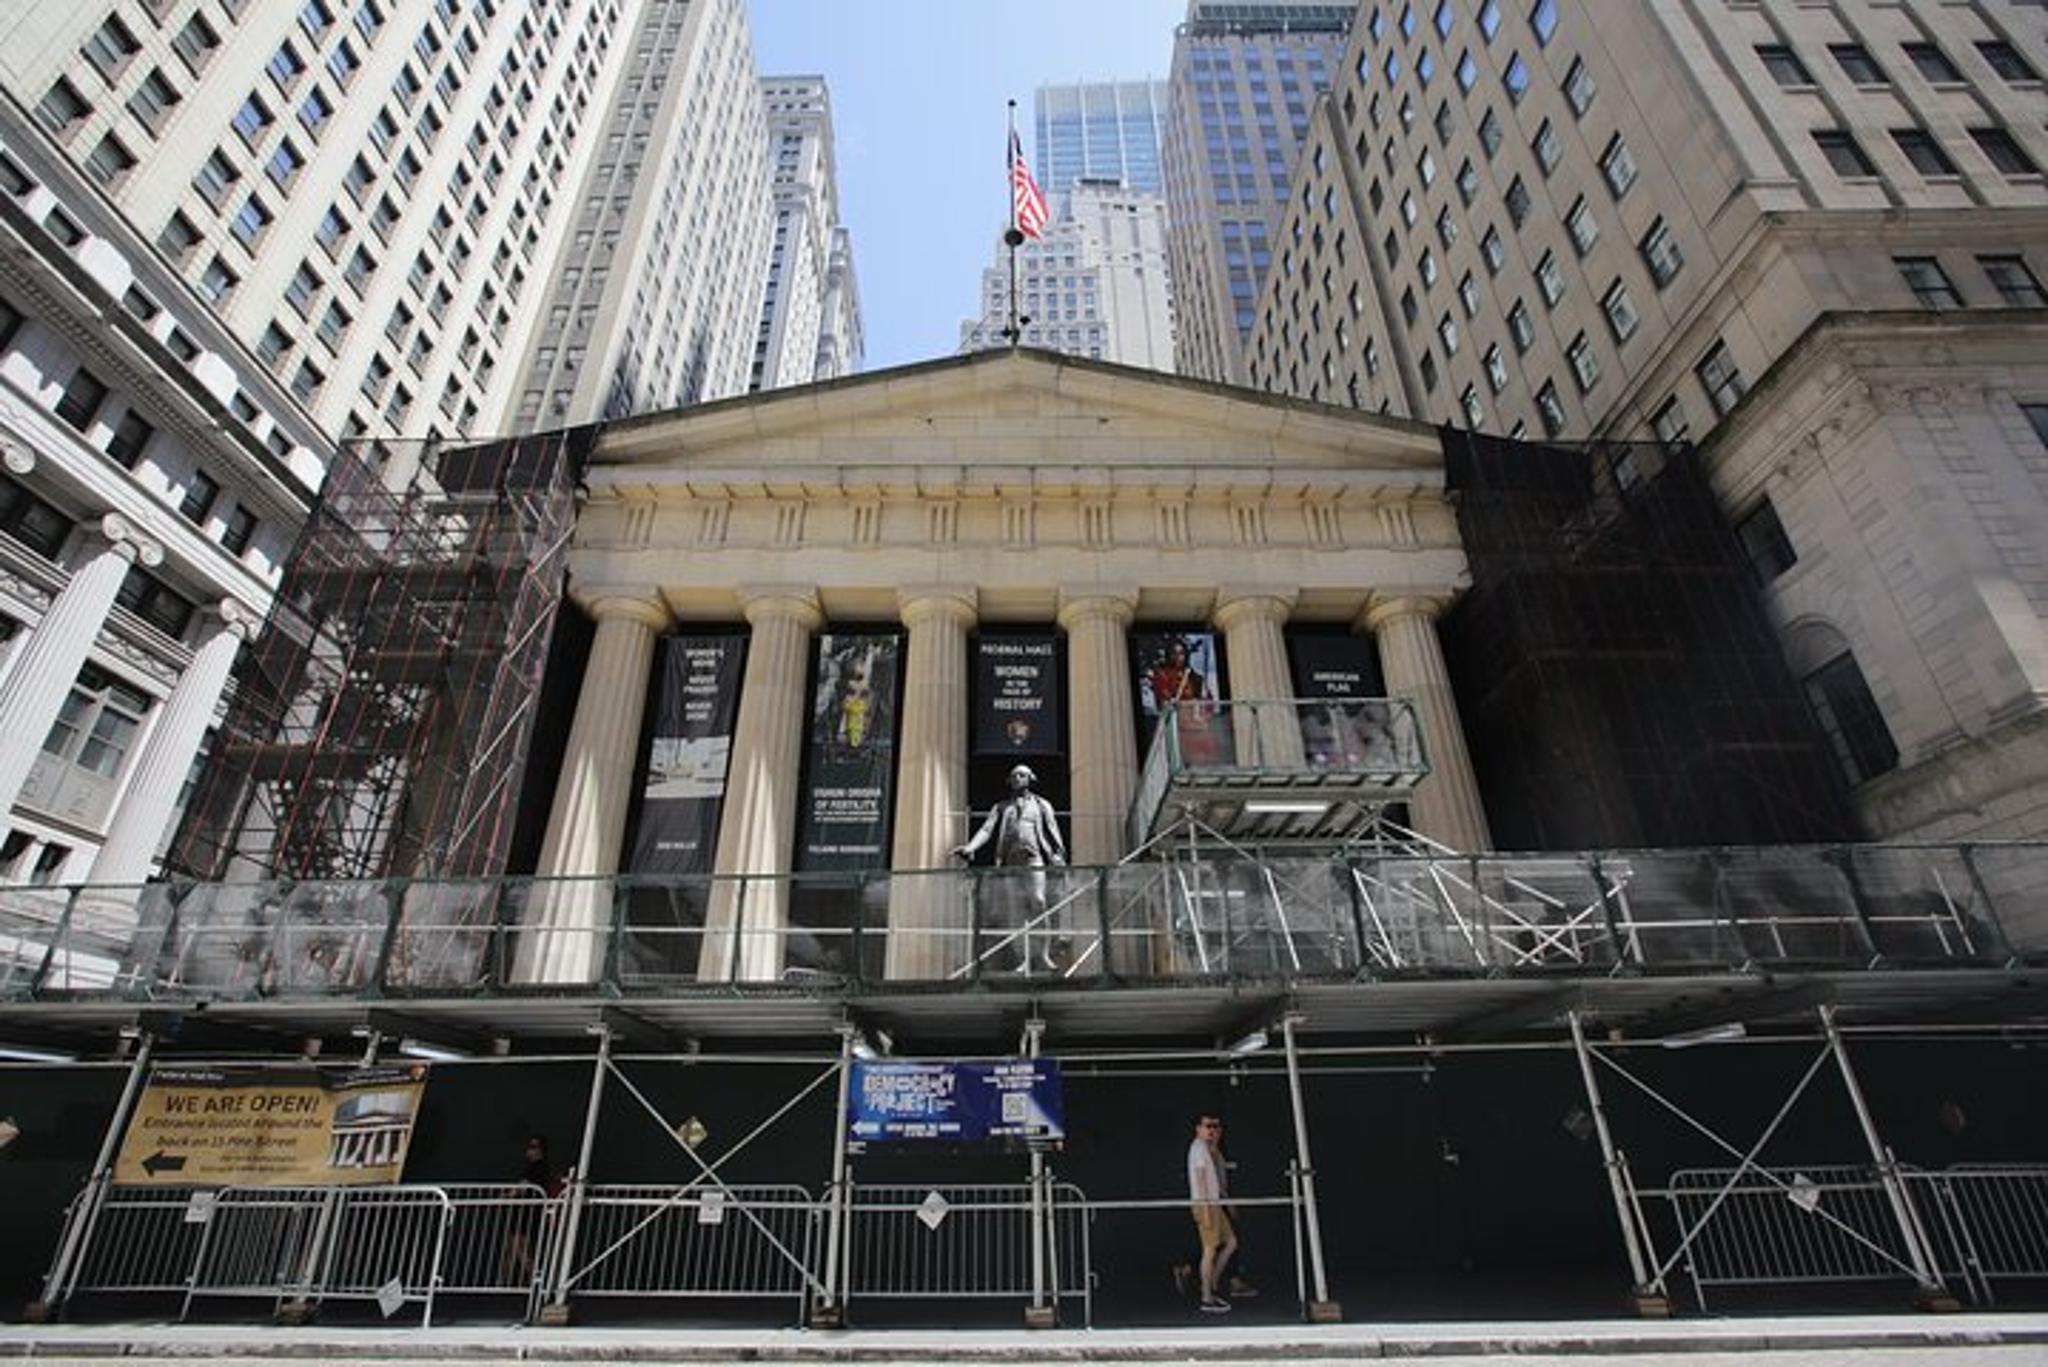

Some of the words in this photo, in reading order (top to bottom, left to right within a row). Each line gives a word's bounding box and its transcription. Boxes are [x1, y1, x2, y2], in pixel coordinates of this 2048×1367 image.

[981, 644, 1023, 655] FEDERAL
[1025, 644, 1052, 655] HALL
[994, 666, 1039, 677] WOMEN
[1313, 672, 1360, 682] AMERICAN
[993, 698, 1043, 710] HISTORY
[165, 1095, 199, 1113] WE
[203, 1095, 246, 1113] ARE
[250, 1094, 320, 1113] OPEN!
[142, 1118, 204, 1130] Entrance
[208, 1117, 251, 1129] located
